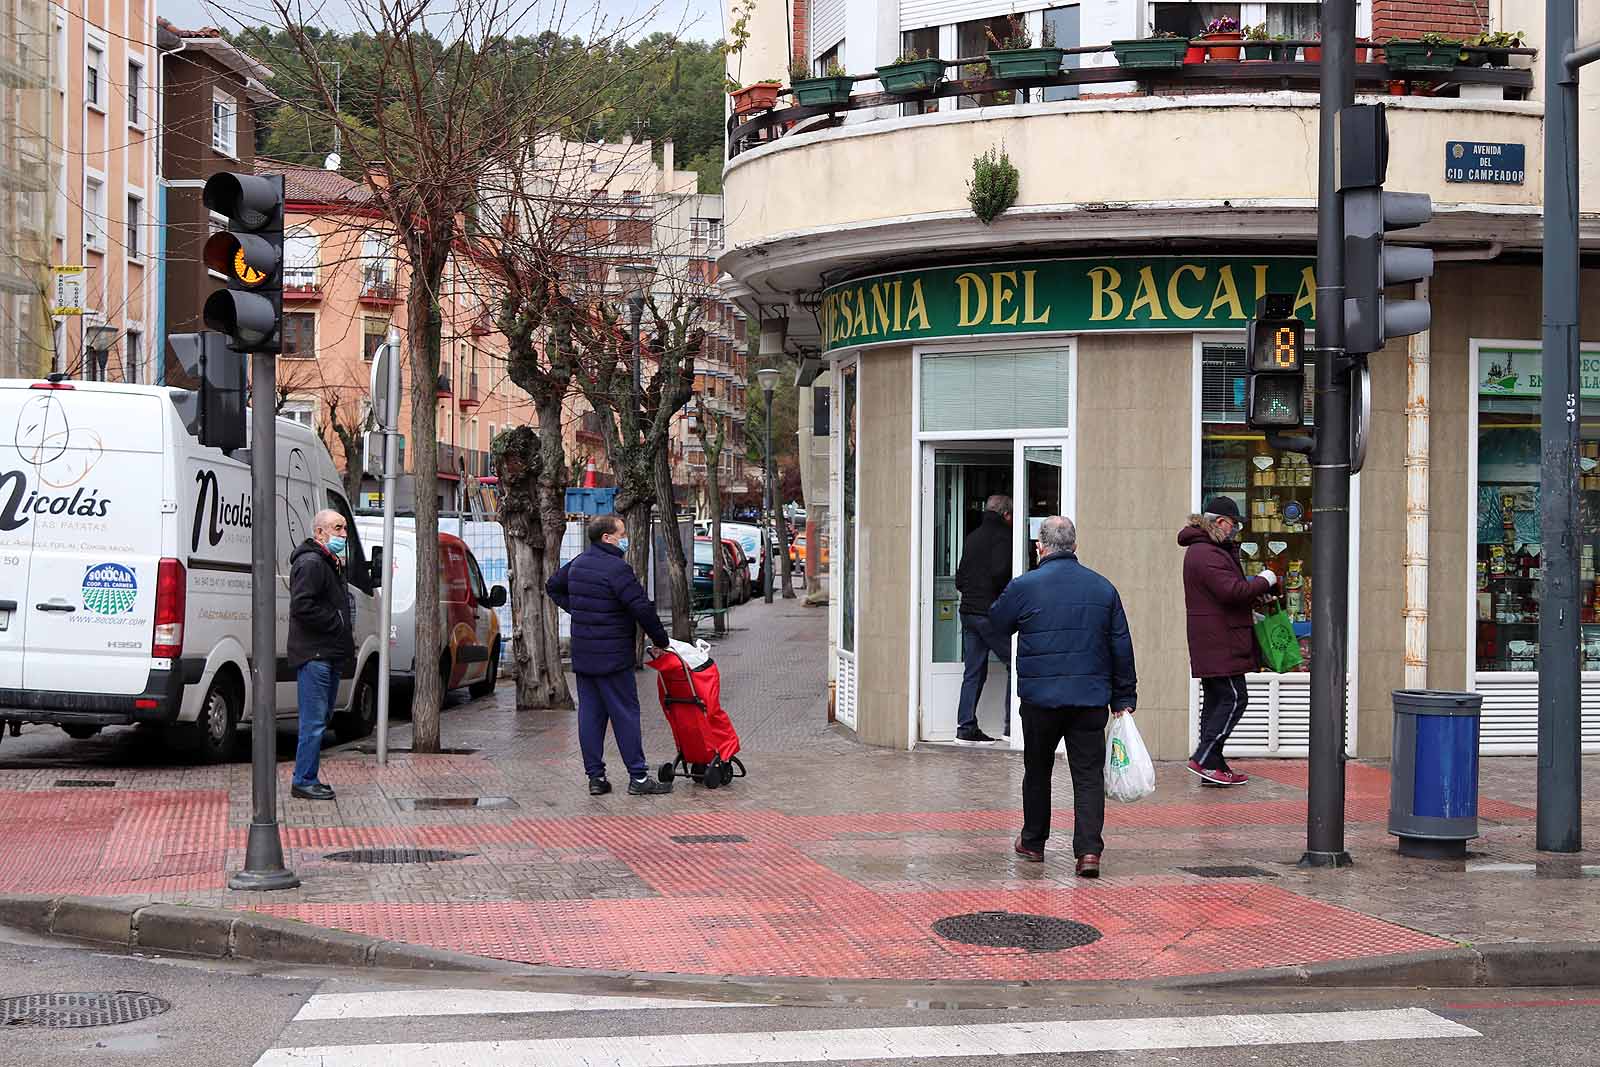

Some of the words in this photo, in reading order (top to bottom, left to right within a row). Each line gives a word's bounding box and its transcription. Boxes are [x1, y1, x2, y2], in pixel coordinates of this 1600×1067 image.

[1473, 145, 1501, 155] AVENIDA
[1479, 157, 1492, 167] DEL
[1447, 168, 1463, 180] CID
[1468, 169, 1524, 182] CAMPEADOR
[955, 270, 1051, 328] DEL
[1276, 327, 1295, 367] 8
[192, 469, 252, 552] Nicolá
[88, 570, 132, 582] SOCOCAR
